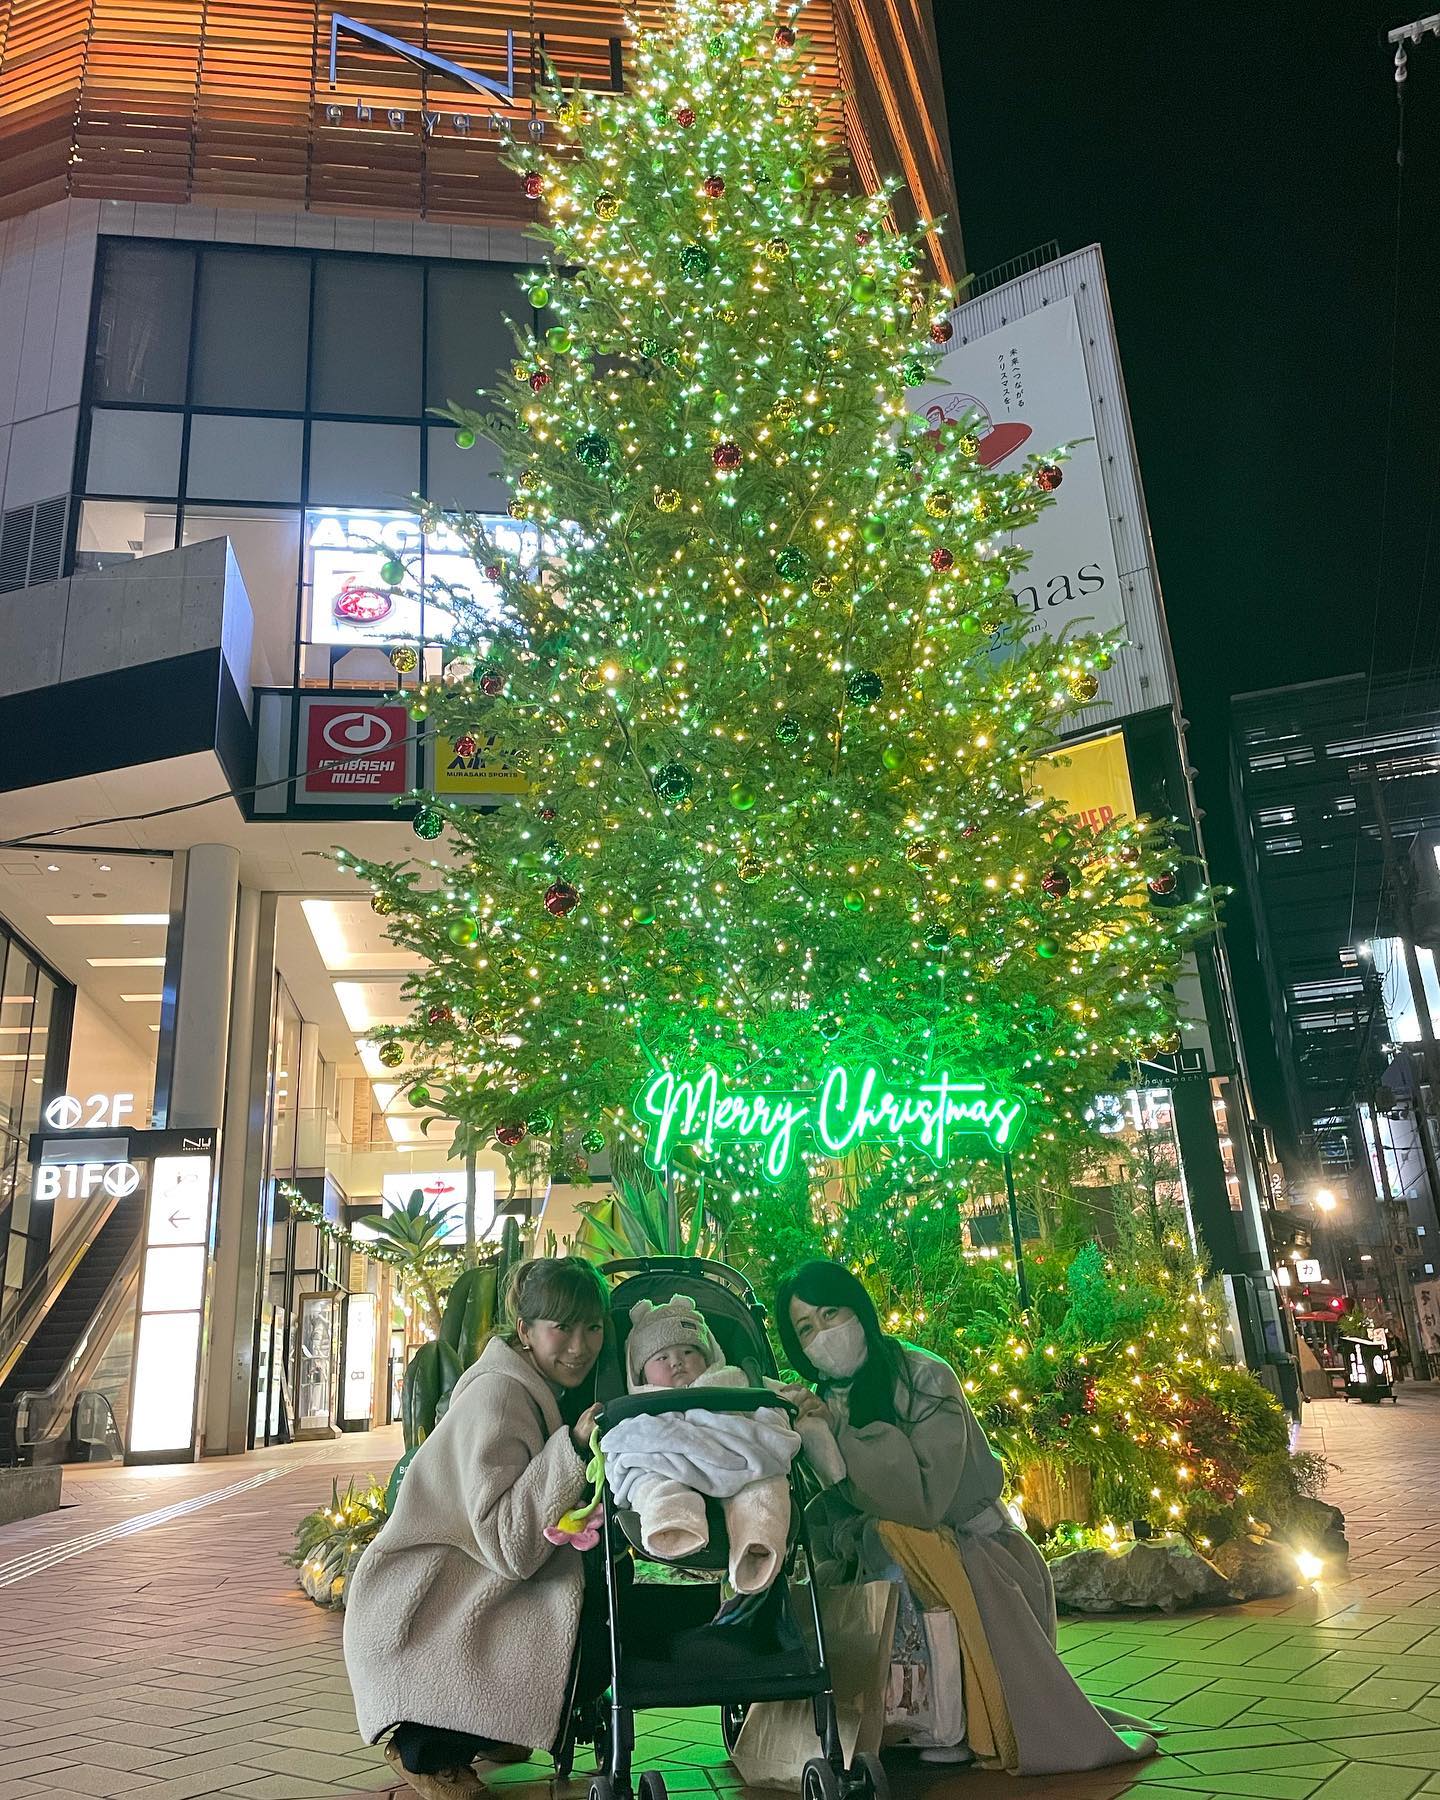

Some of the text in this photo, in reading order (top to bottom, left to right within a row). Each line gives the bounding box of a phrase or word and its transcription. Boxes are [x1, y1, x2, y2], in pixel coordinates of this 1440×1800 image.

[326, 97, 545, 136] chayama
[331, 772, 382, 784] MUSIC
[84, 1093, 134, 1128] 2F
[645, 1067, 1021, 1176] Merry Christmas
[182, 1137, 212, 1148] NU
[35, 1163, 105, 1201] B1F
